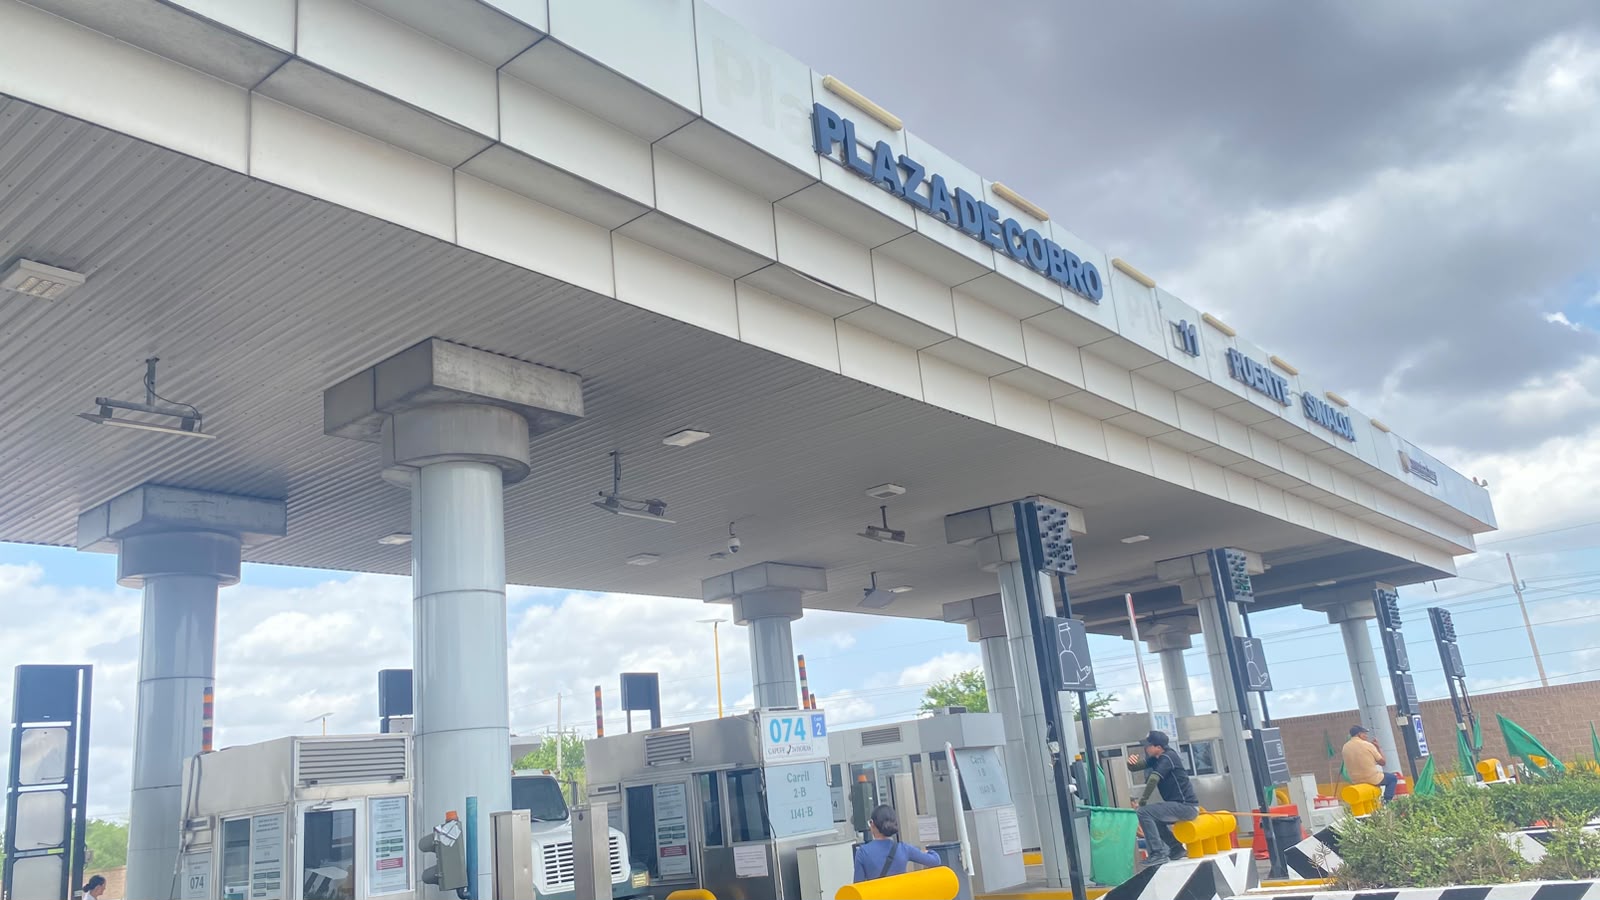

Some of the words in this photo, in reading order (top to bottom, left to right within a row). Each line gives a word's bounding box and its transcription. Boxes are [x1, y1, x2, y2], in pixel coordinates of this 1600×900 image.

[811, 102, 957, 222] PLAZA
[955, 186, 1002, 248] DE
[1001, 217, 1103, 304] COBRO
[1178, 319, 1201, 358] 11
[1226, 347, 1292, 407] PUENTE
[1302, 391, 1357, 442] SINALOA
[769, 716, 806, 744] 074
[815, 722, 823, 736] 2
[786, 770, 810, 783] Carril
[793, 787, 807, 798] 2-B
[190, 876, 204, 890] 074
